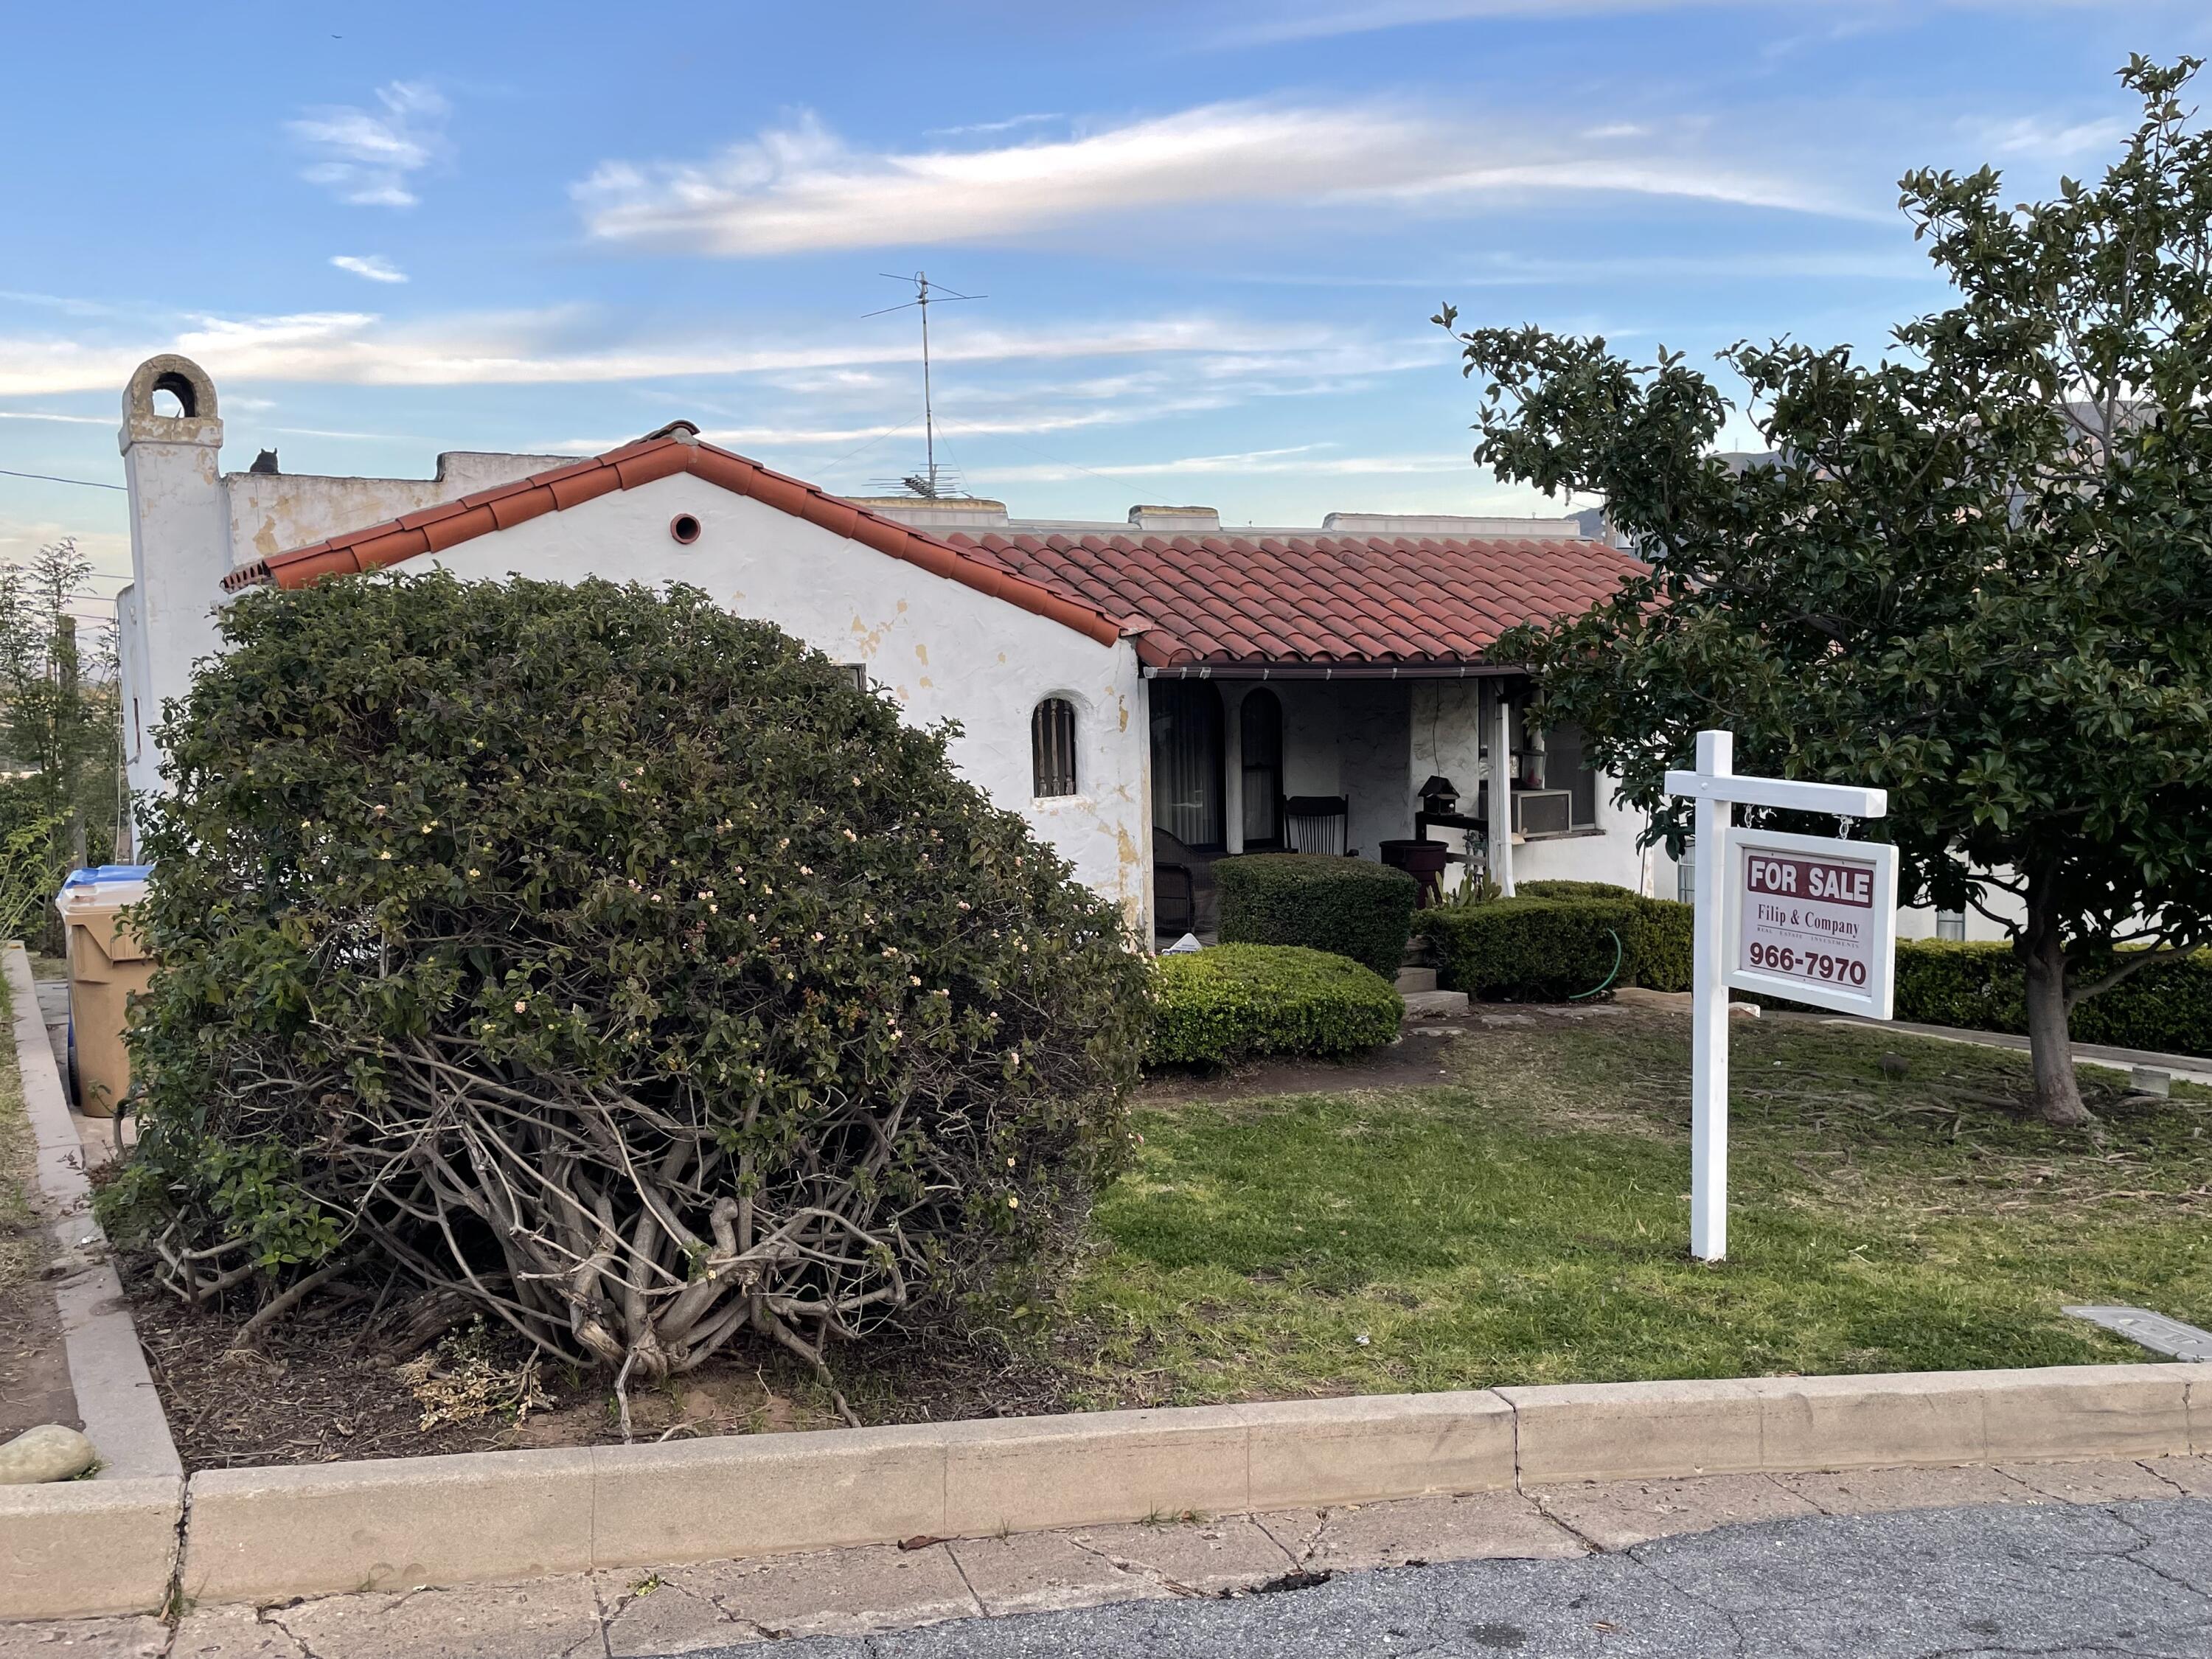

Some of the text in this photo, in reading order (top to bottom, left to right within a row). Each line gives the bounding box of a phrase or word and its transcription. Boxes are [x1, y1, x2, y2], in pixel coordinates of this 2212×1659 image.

[1751, 860, 1870, 903] FOR SALE
[1758, 904, 1860, 938] Filip & Company
[1780, 931, 1803, 939] ESTATE
[1811, 936, 1860, 949] INVESTMENTS
[1750, 942, 1866, 985] 966-7970
